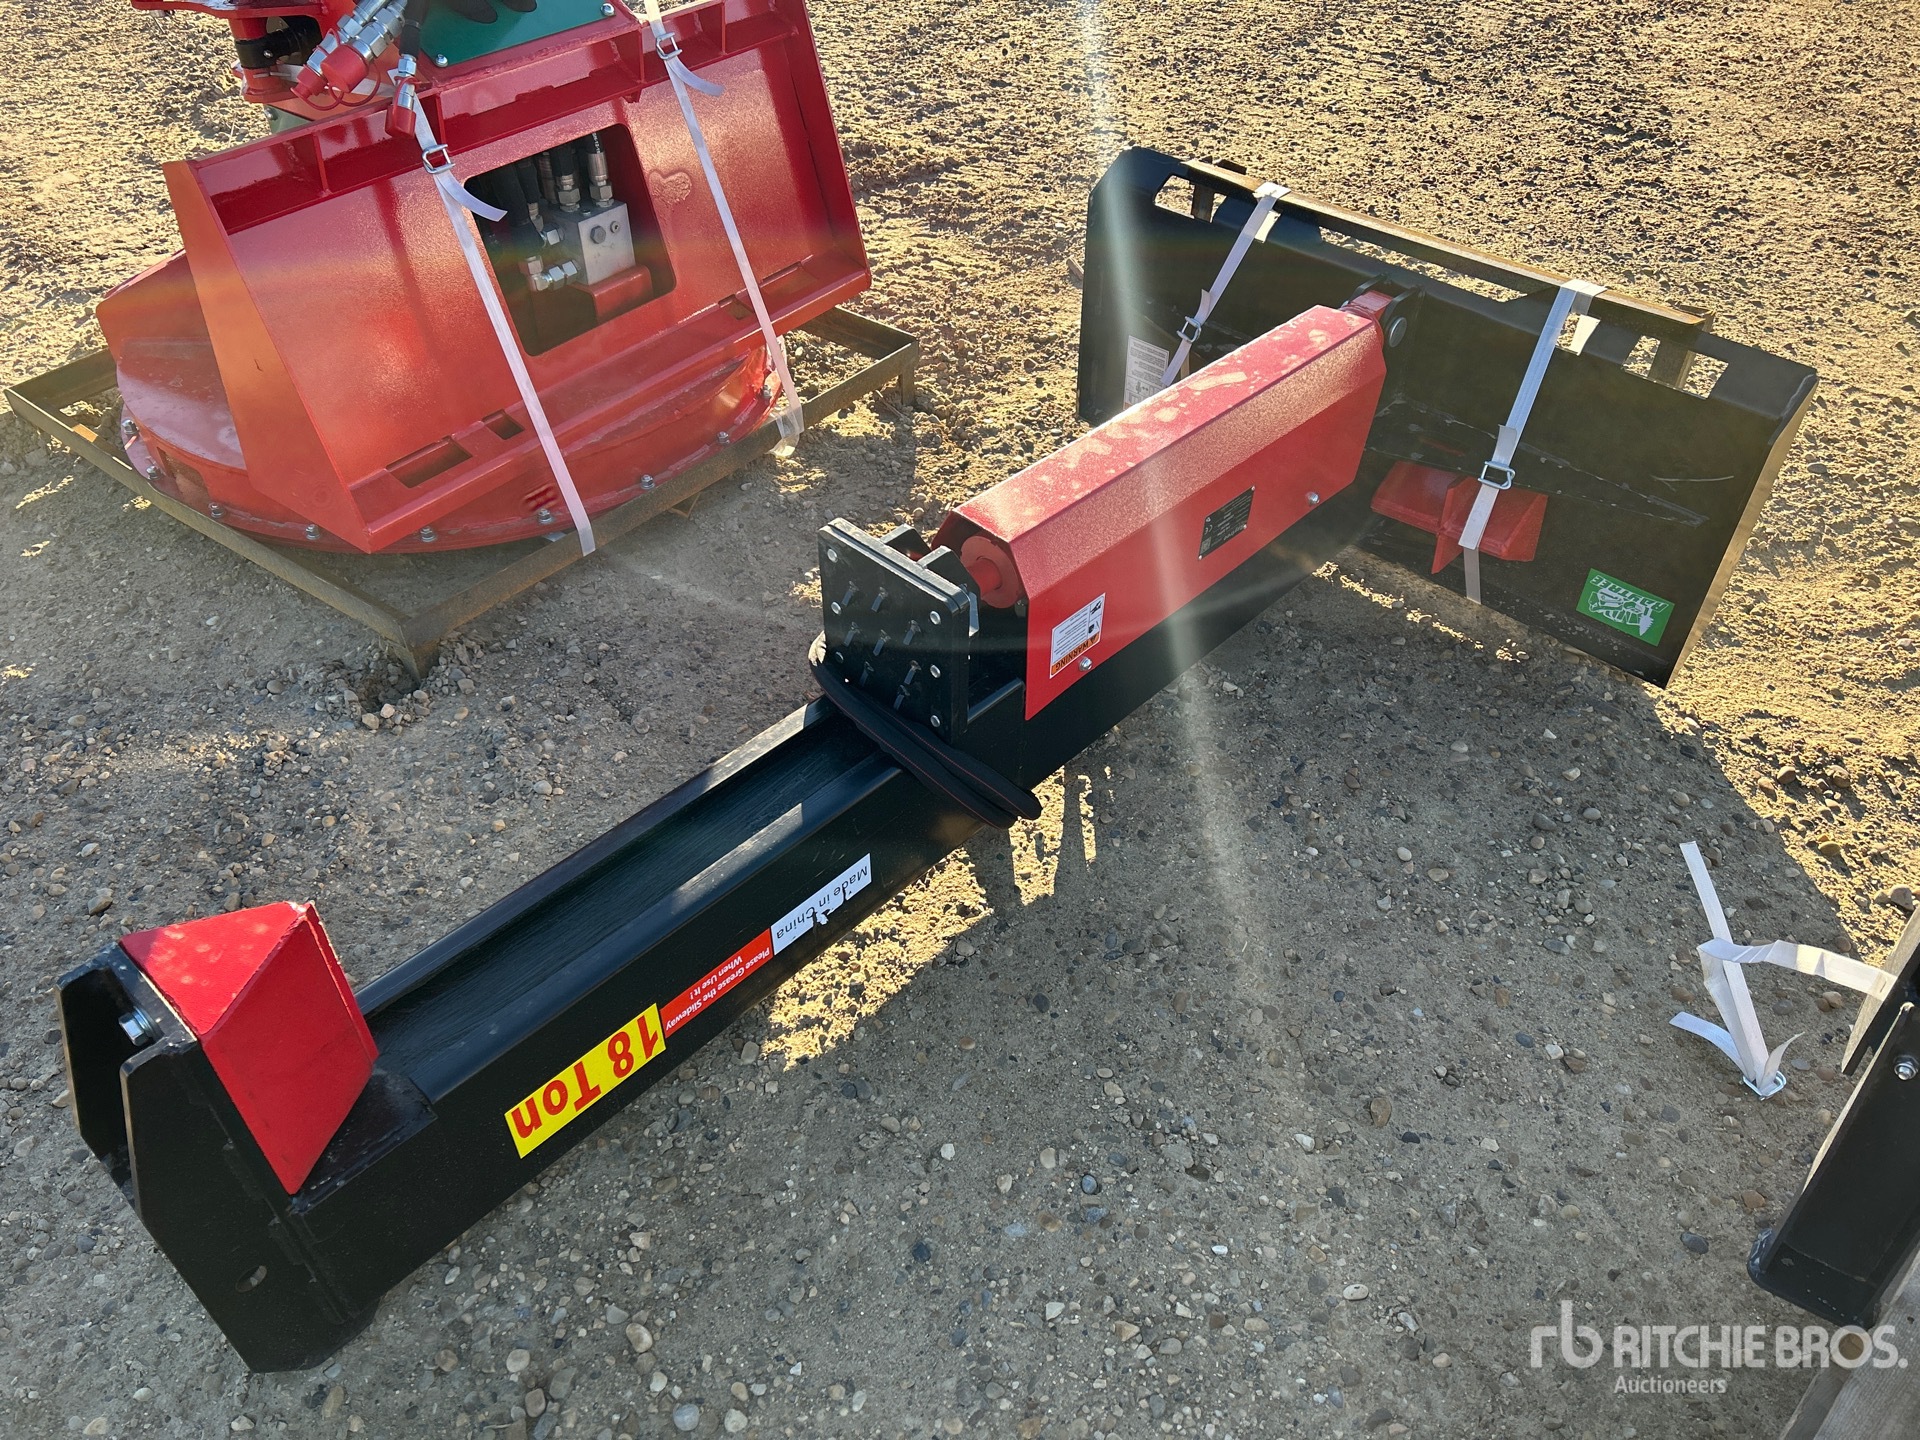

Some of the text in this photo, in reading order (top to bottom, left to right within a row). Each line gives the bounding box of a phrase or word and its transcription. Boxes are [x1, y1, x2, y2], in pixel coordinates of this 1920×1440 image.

[1590, 574, 1669, 613] RAYTREE
[1055, 640, 1089, 671] WARNING
[776, 866, 868, 939] Made in China
[701, 974, 718, 989] Use
[718, 955, 743, 977] When
[666, 947, 770, 1031] Please Grease the Slideway
[511, 1015, 659, 1139] 18 Ton
